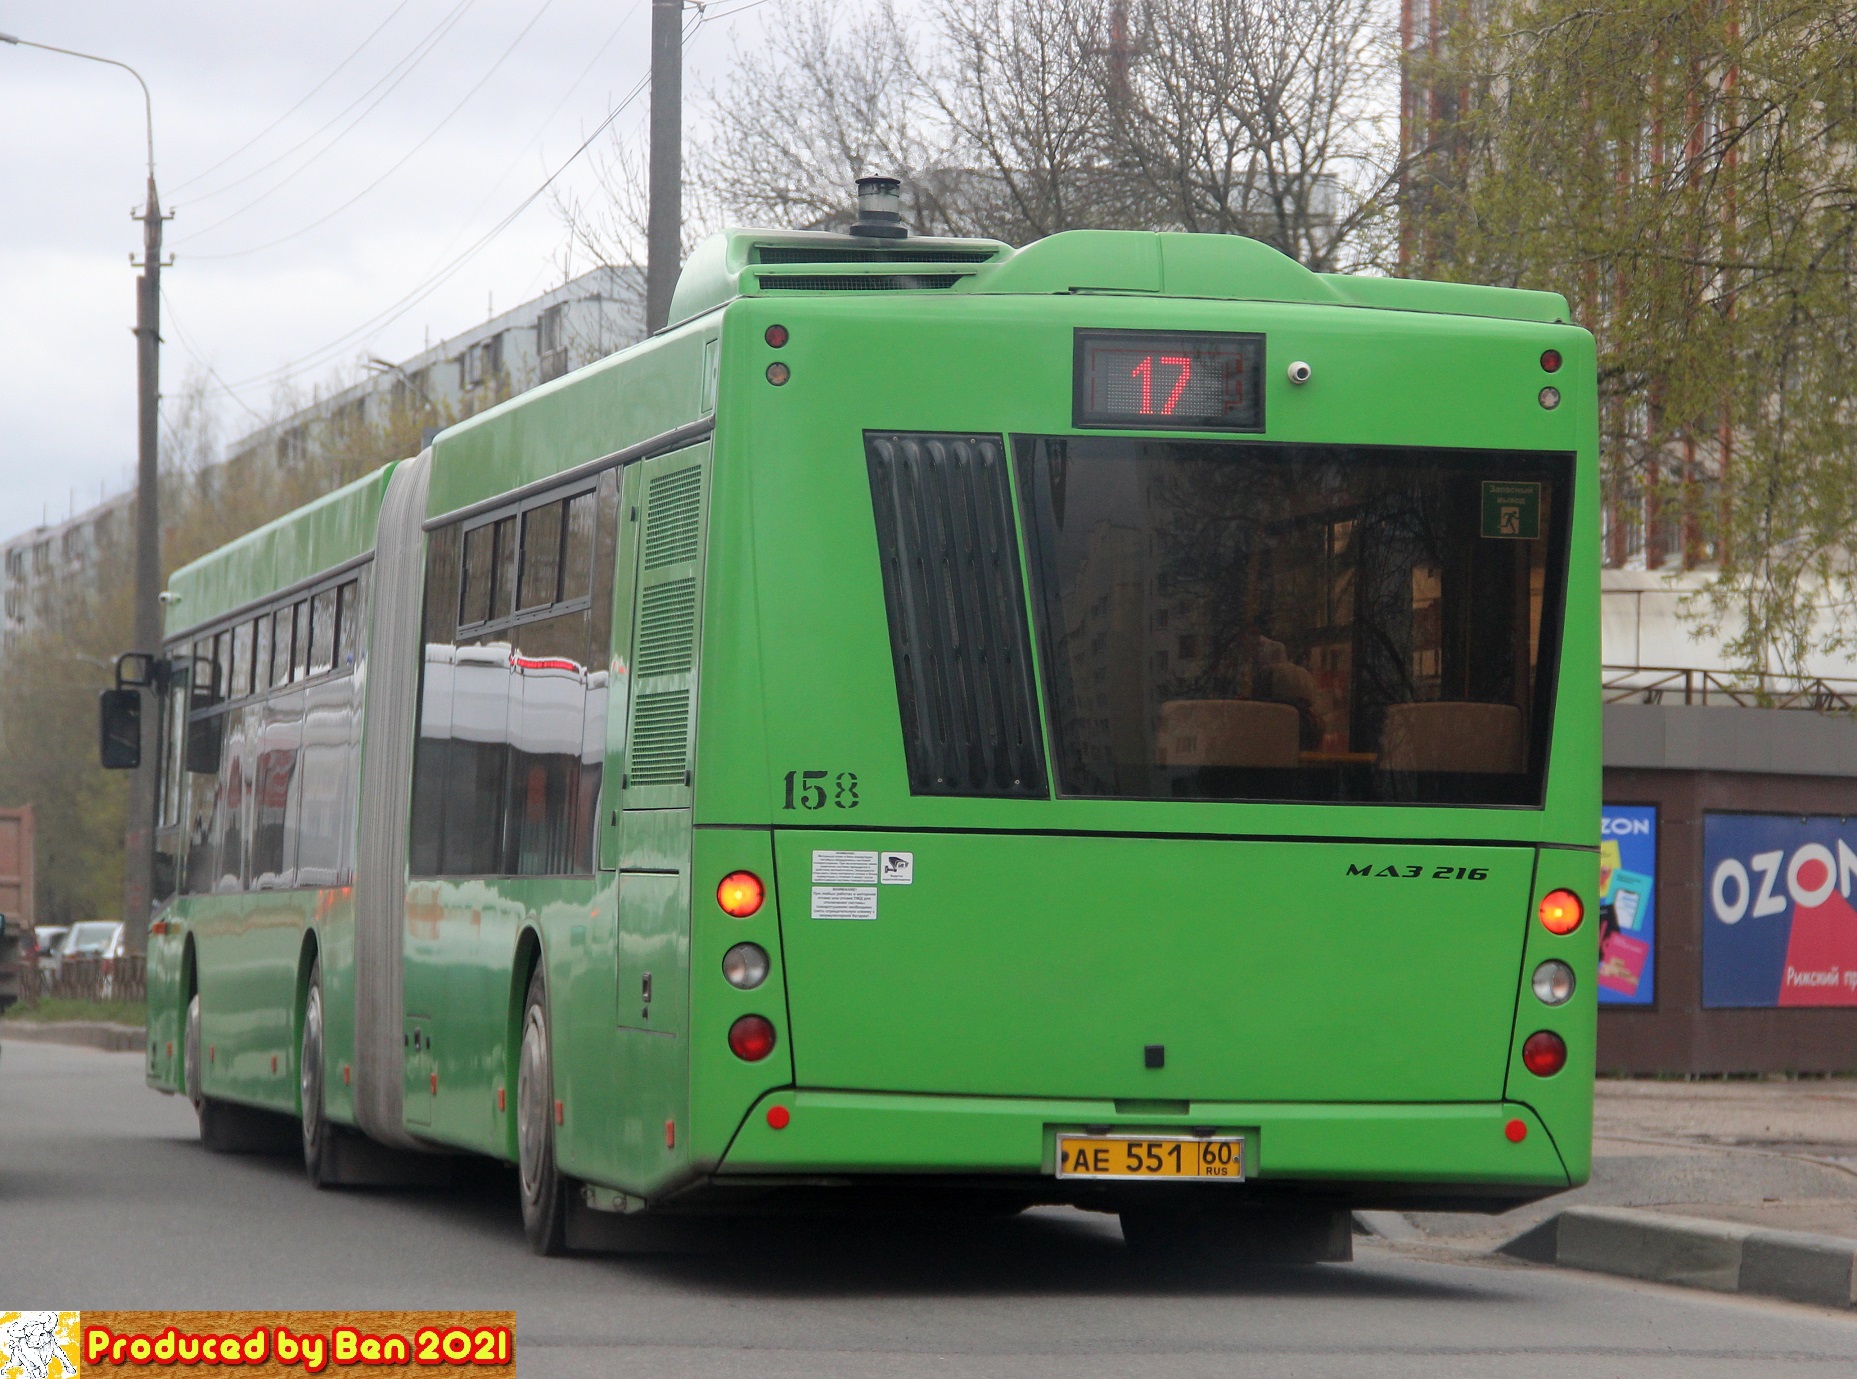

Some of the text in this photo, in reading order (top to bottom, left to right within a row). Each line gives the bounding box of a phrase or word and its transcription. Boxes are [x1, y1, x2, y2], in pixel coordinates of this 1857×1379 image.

[1132, 356, 1190, 415] 17
[782, 770, 860, 810] 158
[1346, 863, 1490, 881] МАЗ 216
[1787, 966, 1839, 986] Рижский
[1073, 1142, 1232, 1173] AE 551 60
[1206, 1166, 1228, 1176] RUS
